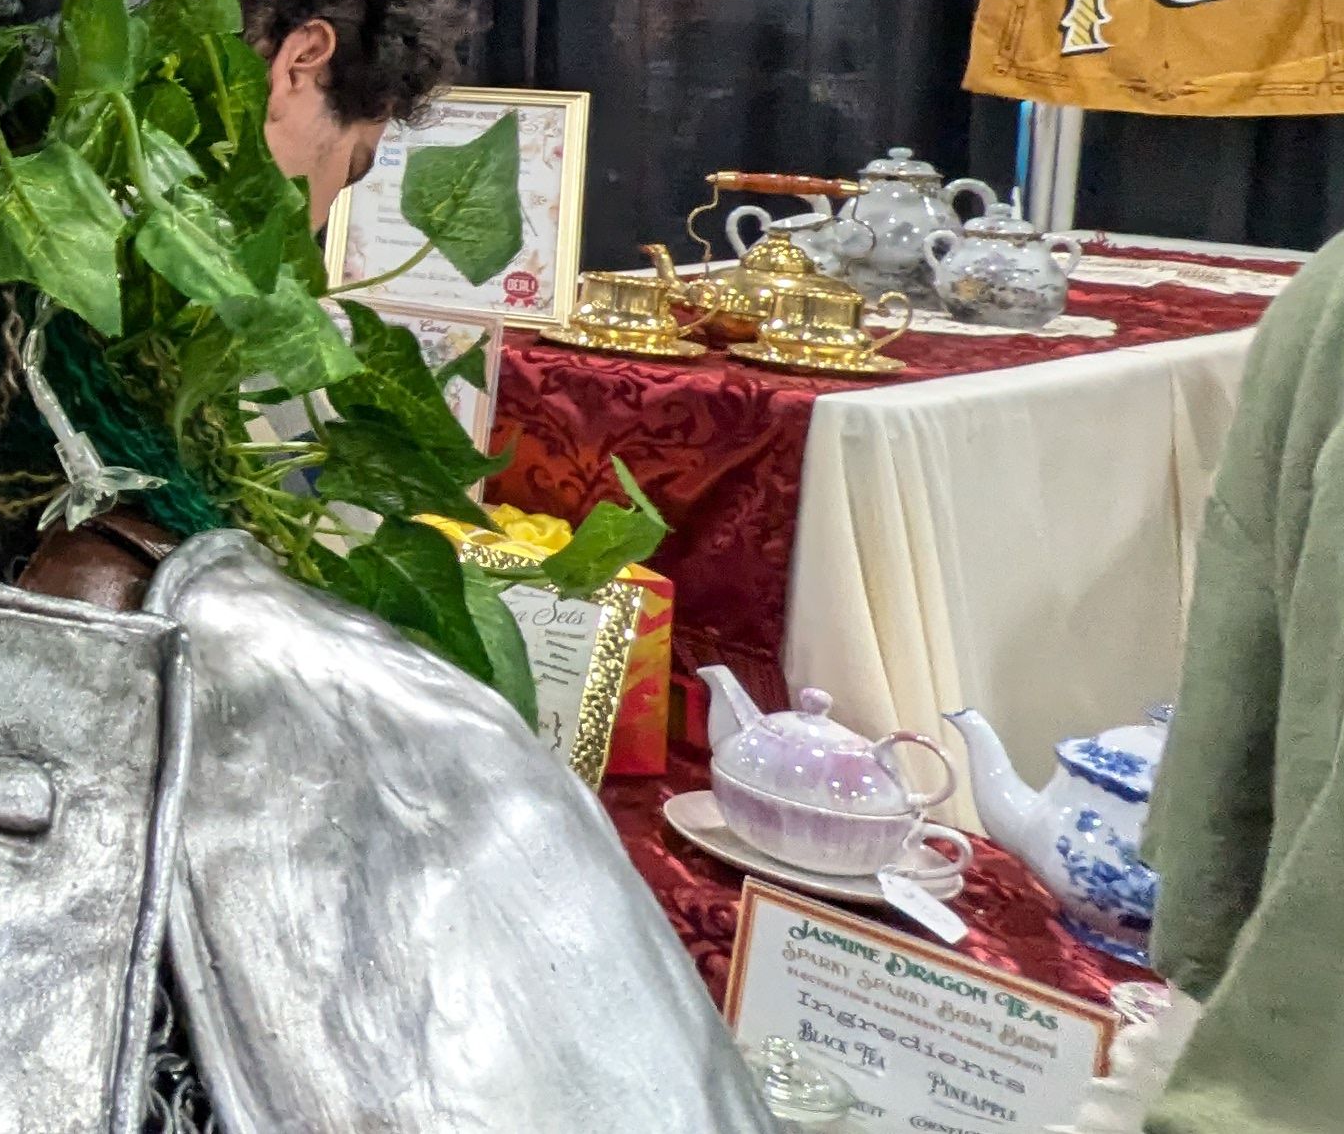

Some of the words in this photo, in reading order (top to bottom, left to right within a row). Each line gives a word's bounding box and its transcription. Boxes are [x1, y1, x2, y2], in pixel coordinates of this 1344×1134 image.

[788, 919, 881, 965] JASMINE
[884, 951, 988, 1005] DRAGON
[994, 991, 1059, 1030] TEAS
[797, 989, 1026, 1094] Ingredients
